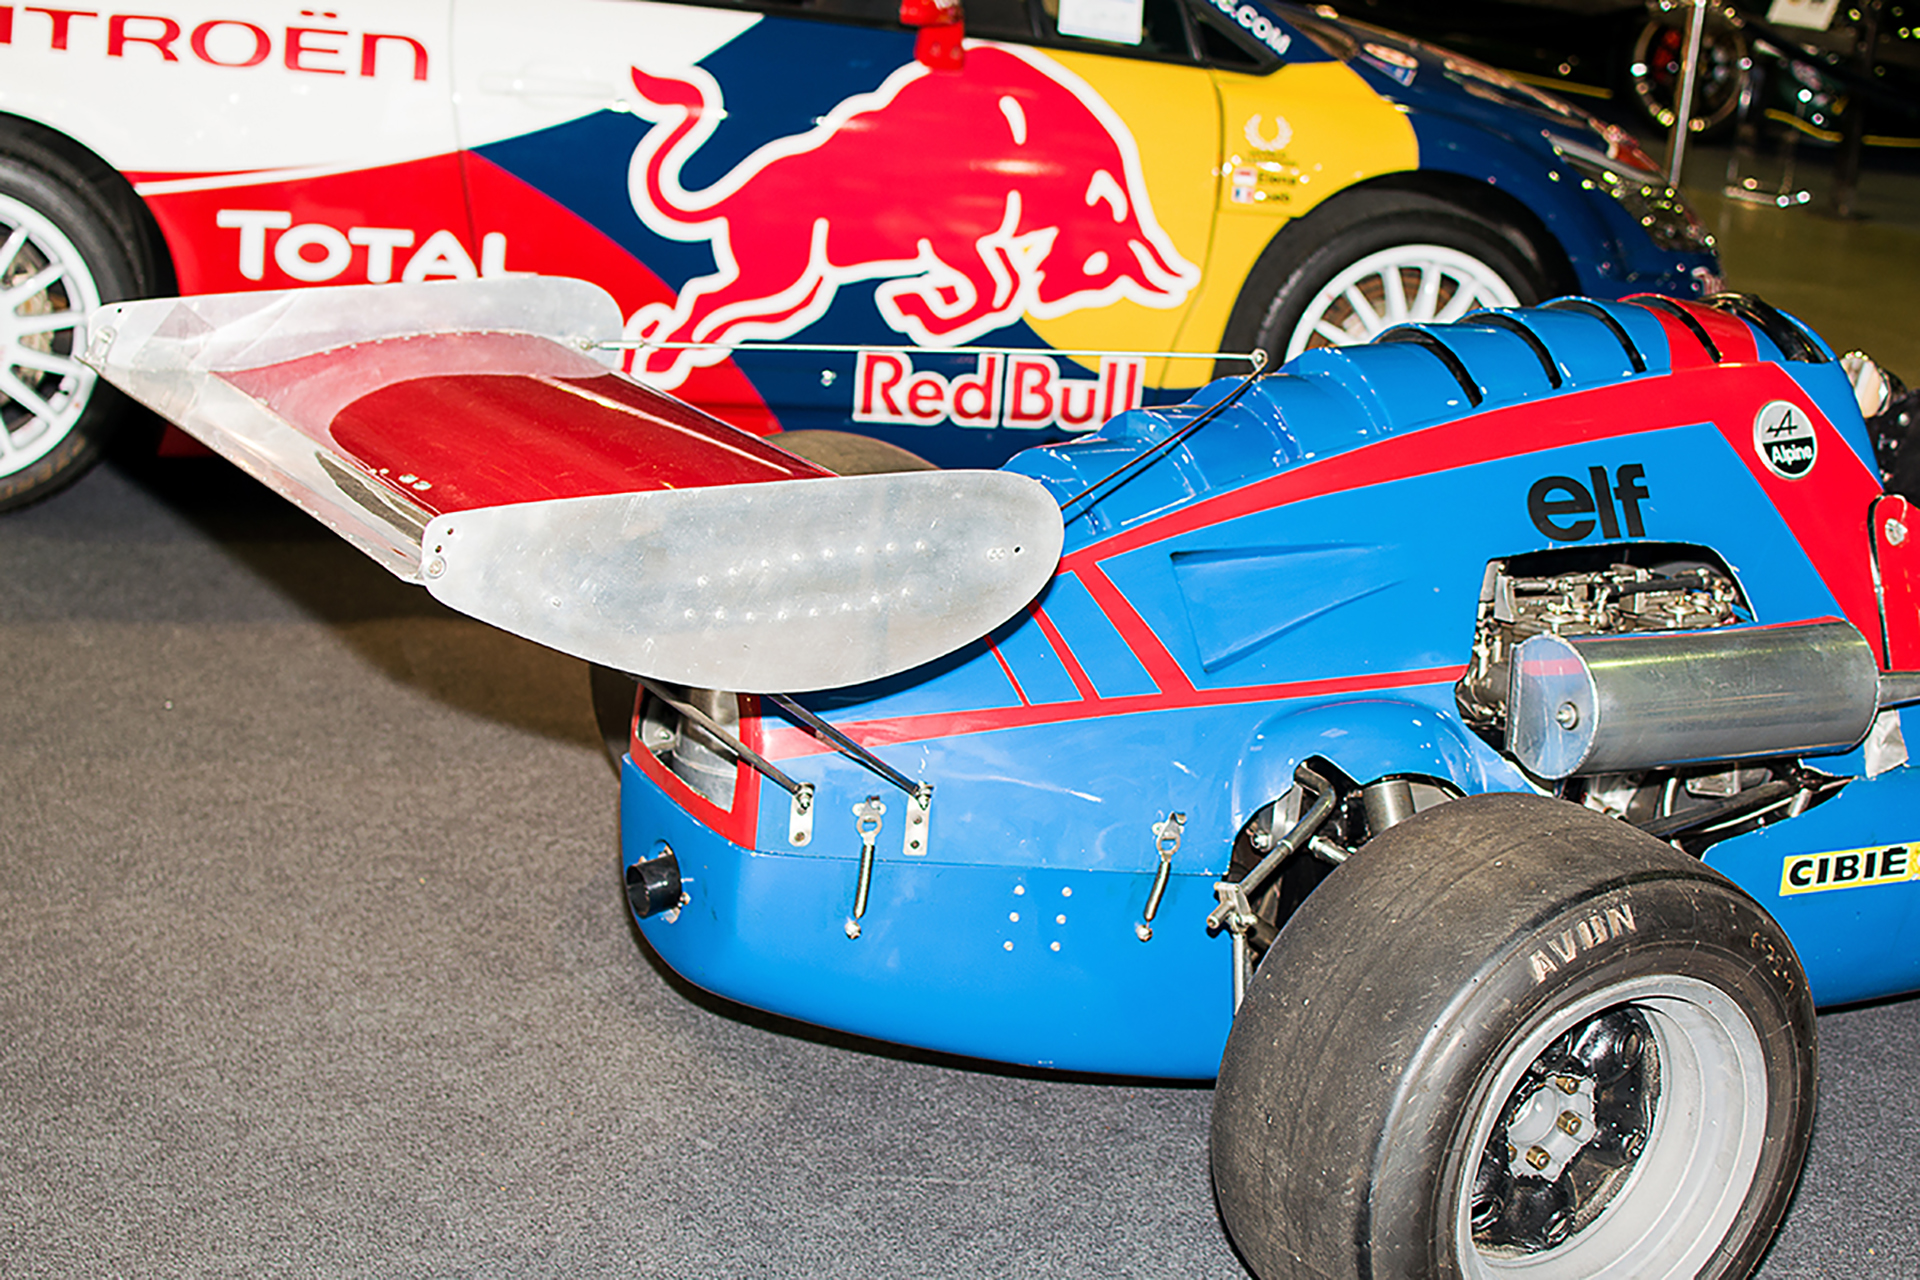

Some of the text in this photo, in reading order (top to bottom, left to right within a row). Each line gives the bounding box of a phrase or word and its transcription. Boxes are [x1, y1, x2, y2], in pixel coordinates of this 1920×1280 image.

[216, 209, 539, 283] TOTAL
[859, 353, 1139, 425] Red Bull
[1771, 444, 1814, 466] Alpine
[1527, 463, 1650, 542] elf
[1529, 903, 1638, 985] AVON
